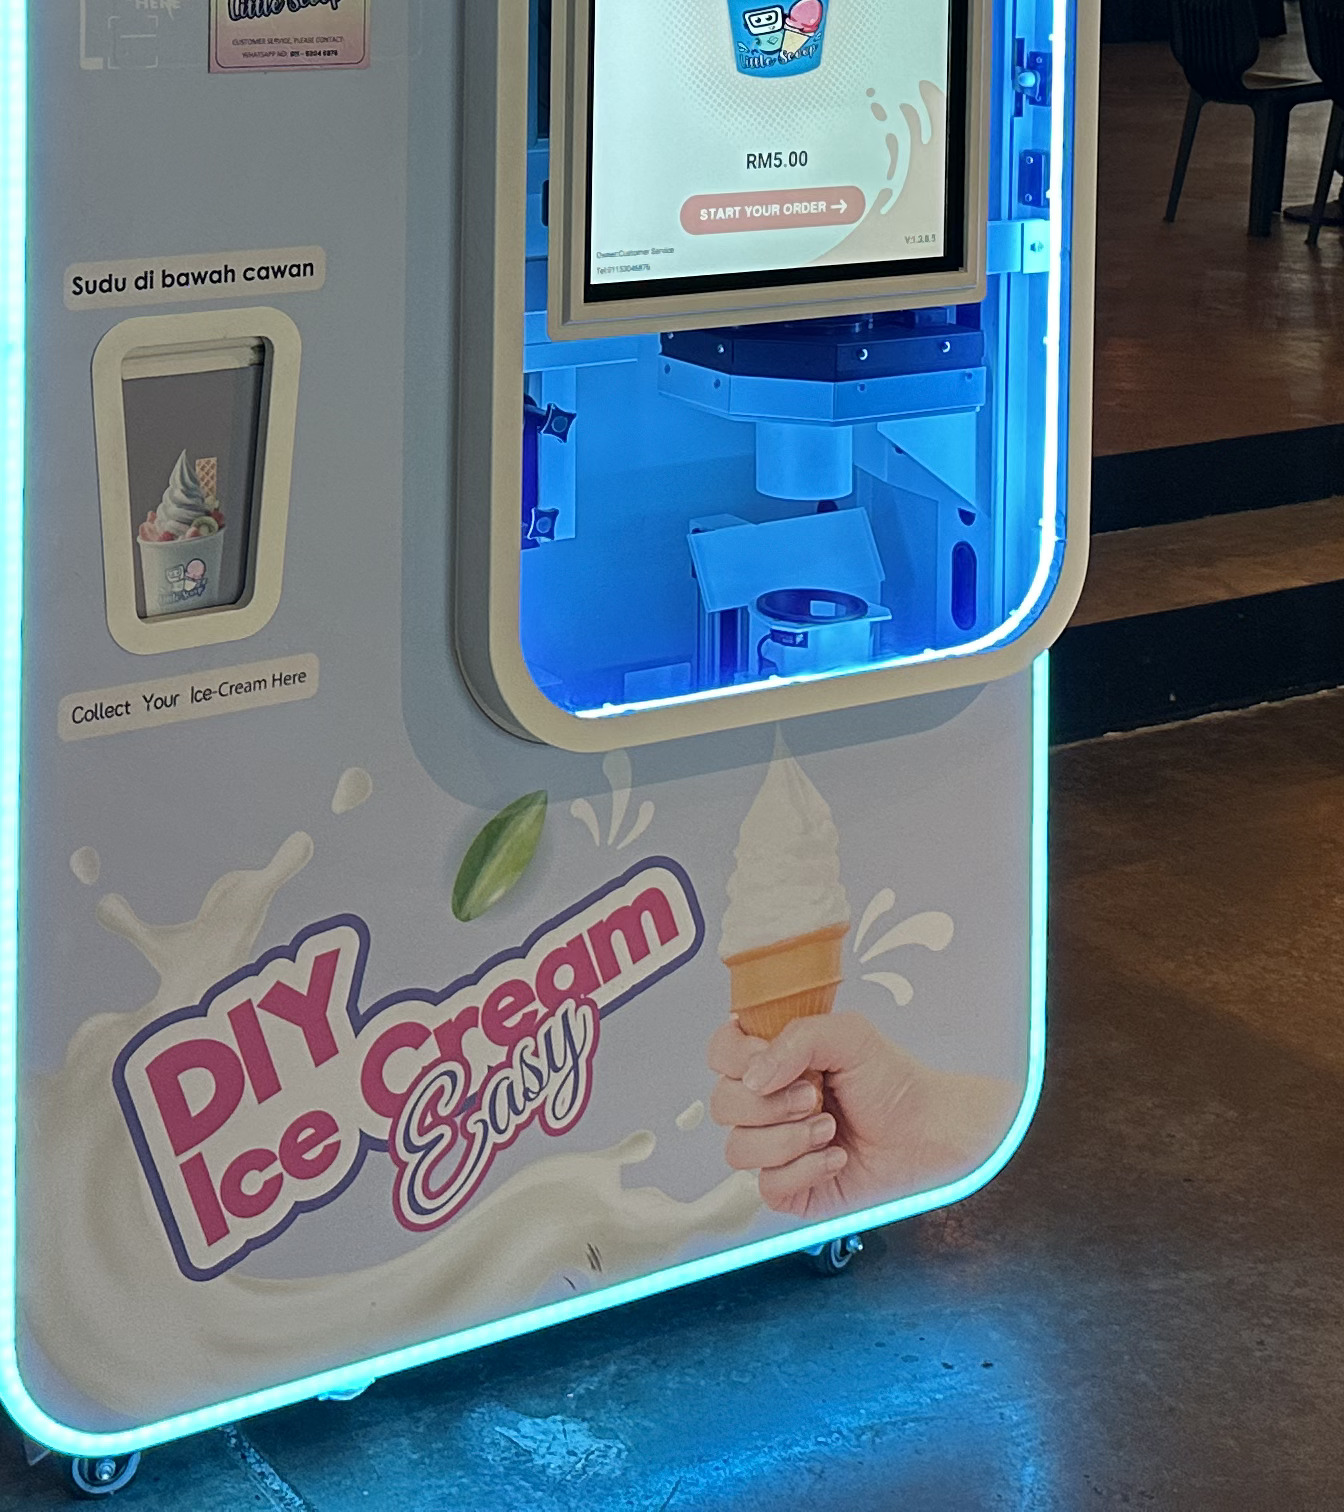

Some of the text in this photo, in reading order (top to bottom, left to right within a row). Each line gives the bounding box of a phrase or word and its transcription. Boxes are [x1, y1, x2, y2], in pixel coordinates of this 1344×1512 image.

[232, 38, 266, 46] CUSTOMER
[294, 36, 314, 44] PLEASE
[740, 52, 776, 69] Little
[747, 151, 808, 169] RM5.00
[700, 201, 827, 221] START YOUR ORDER
[72, 261, 315, 297] Sudu di bawah cawan
[71, 669, 307, 725] Collect Your Ice-Cream Here
[146, 948, 341, 1157] DIY
[179, 887, 679, 1247] Ice Cream
[398, 997, 590, 1221] Easy
